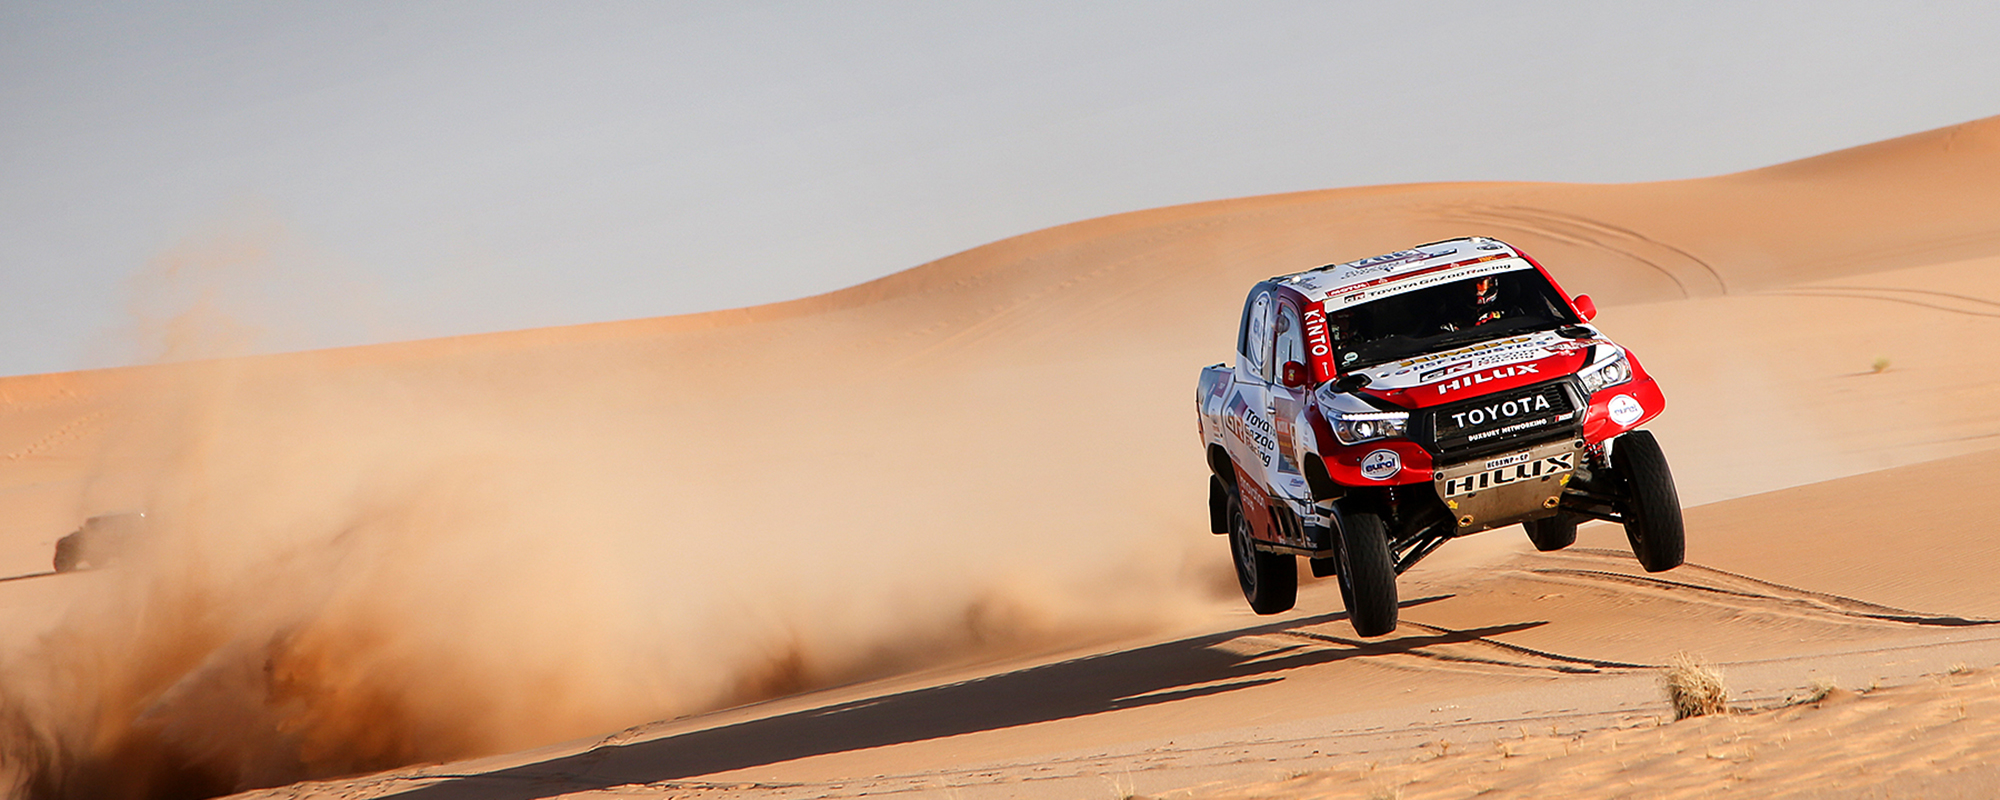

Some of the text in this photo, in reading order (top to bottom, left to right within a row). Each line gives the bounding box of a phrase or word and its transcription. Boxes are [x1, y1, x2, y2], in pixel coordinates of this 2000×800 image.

[1369, 280, 1418, 297] TOYOTA
[1419, 272, 1465, 285] GAZOO
[1437, 363, 1540, 396] HILUX
[1246, 408, 1277, 438] TOYOTA
[1451, 394, 1551, 429] TOYOTA
[1467, 418, 1548, 442] DUXBURY NETWORKING
[1365, 457, 1396, 472] eurol
[1446, 453, 1573, 496] HILUX
